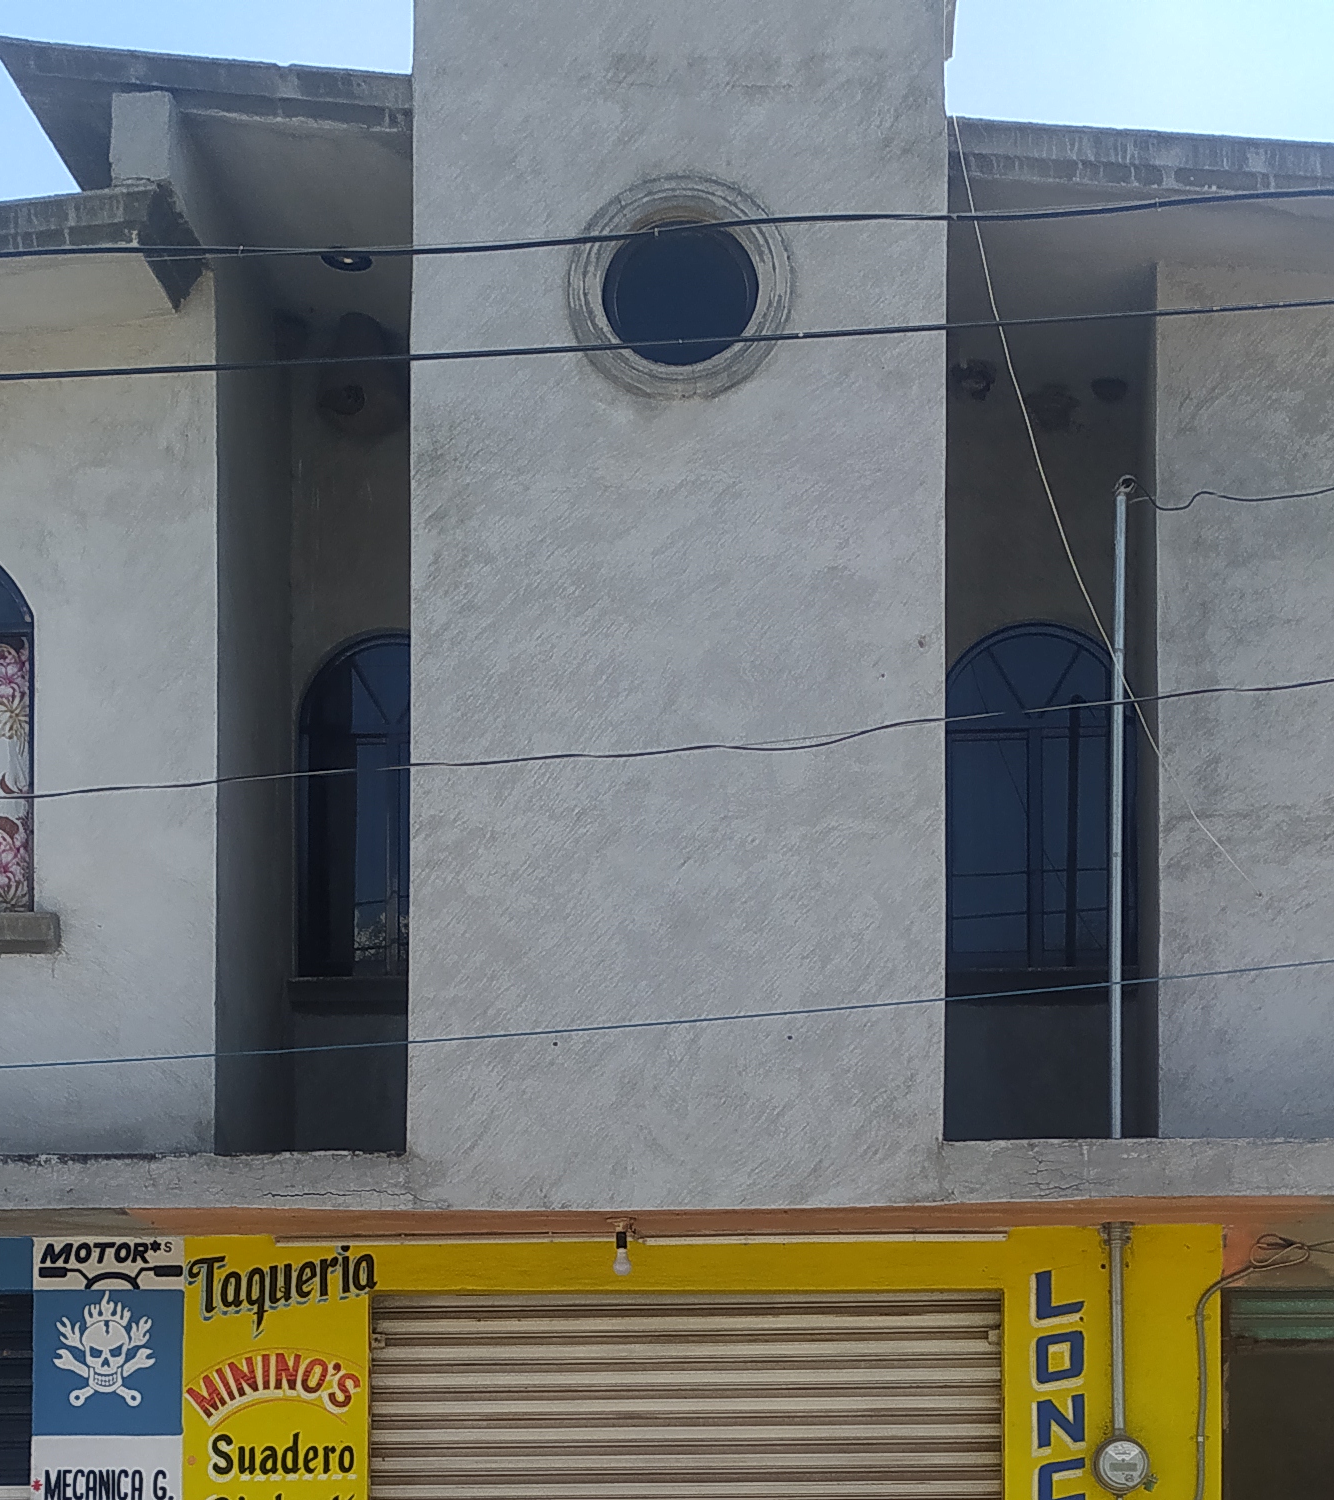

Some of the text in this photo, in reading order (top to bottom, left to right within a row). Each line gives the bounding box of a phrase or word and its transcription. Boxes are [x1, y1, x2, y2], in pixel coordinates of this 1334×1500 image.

[187, 1245, 378, 1334] Taqueria
[185, 1352, 362, 1422] MININO'S
[210, 1432, 356, 1476] Suadero
